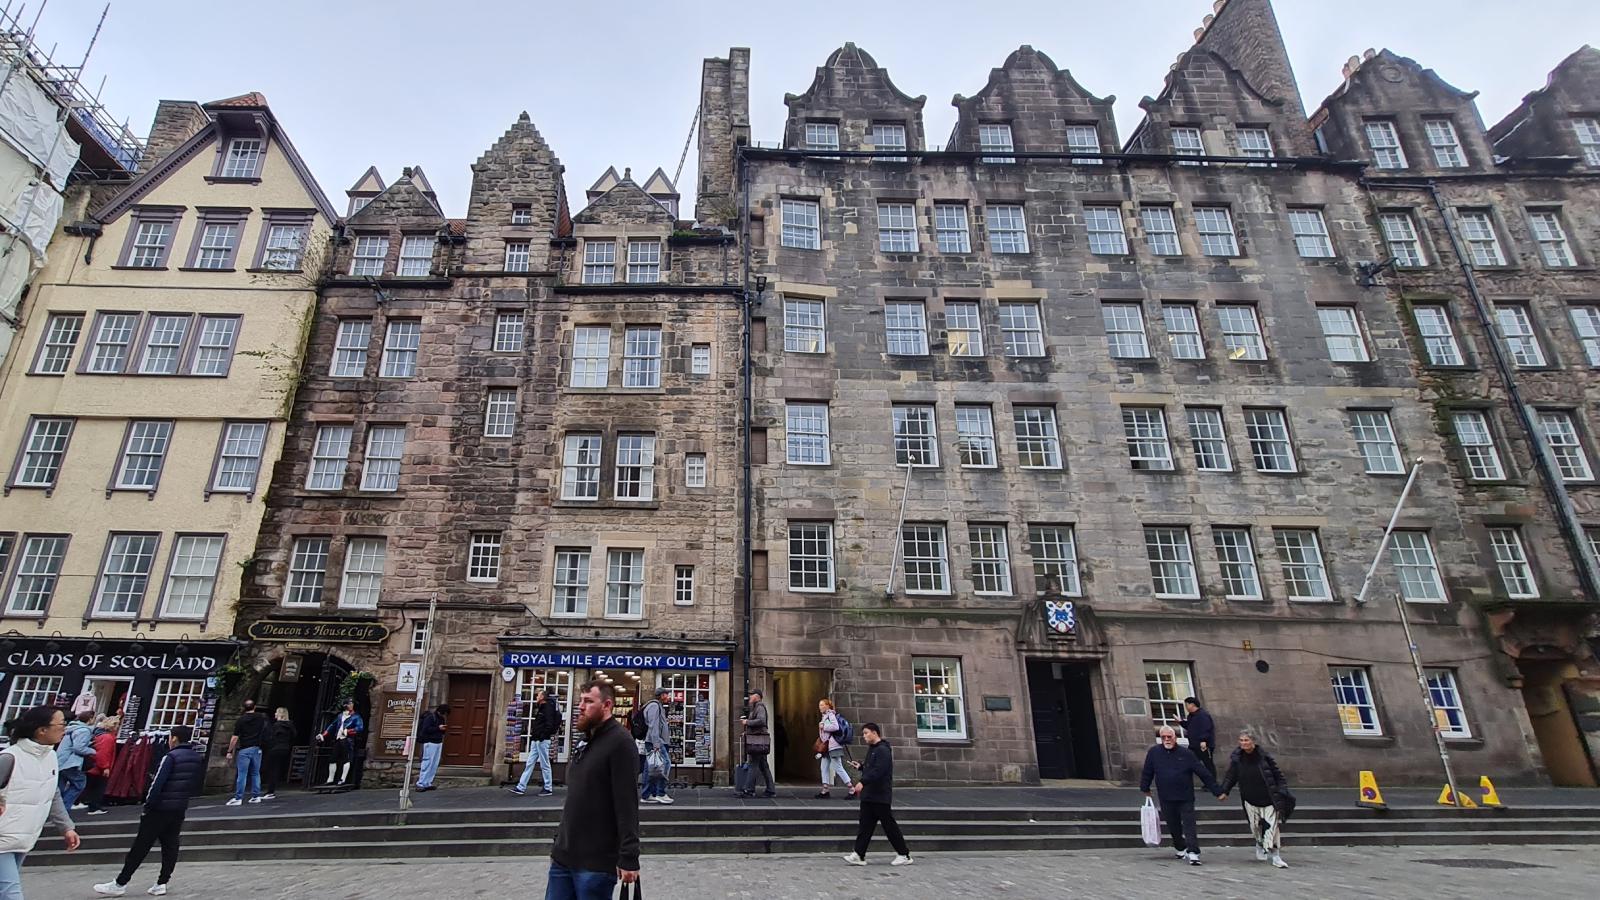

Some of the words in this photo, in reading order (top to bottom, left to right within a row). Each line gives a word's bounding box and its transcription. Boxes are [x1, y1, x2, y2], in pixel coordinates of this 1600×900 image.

[312, 624, 346, 637] House
[7, 650, 73, 667] CLANS
[79, 653, 105, 670] OF
[109, 653, 216, 671] SCOTLAND
[510, 654, 555, 665] ROYAL
[560, 655, 592, 665] MILE
[597, 655, 662, 666] FACTORY
[666, 656, 721, 668] OUTLET
